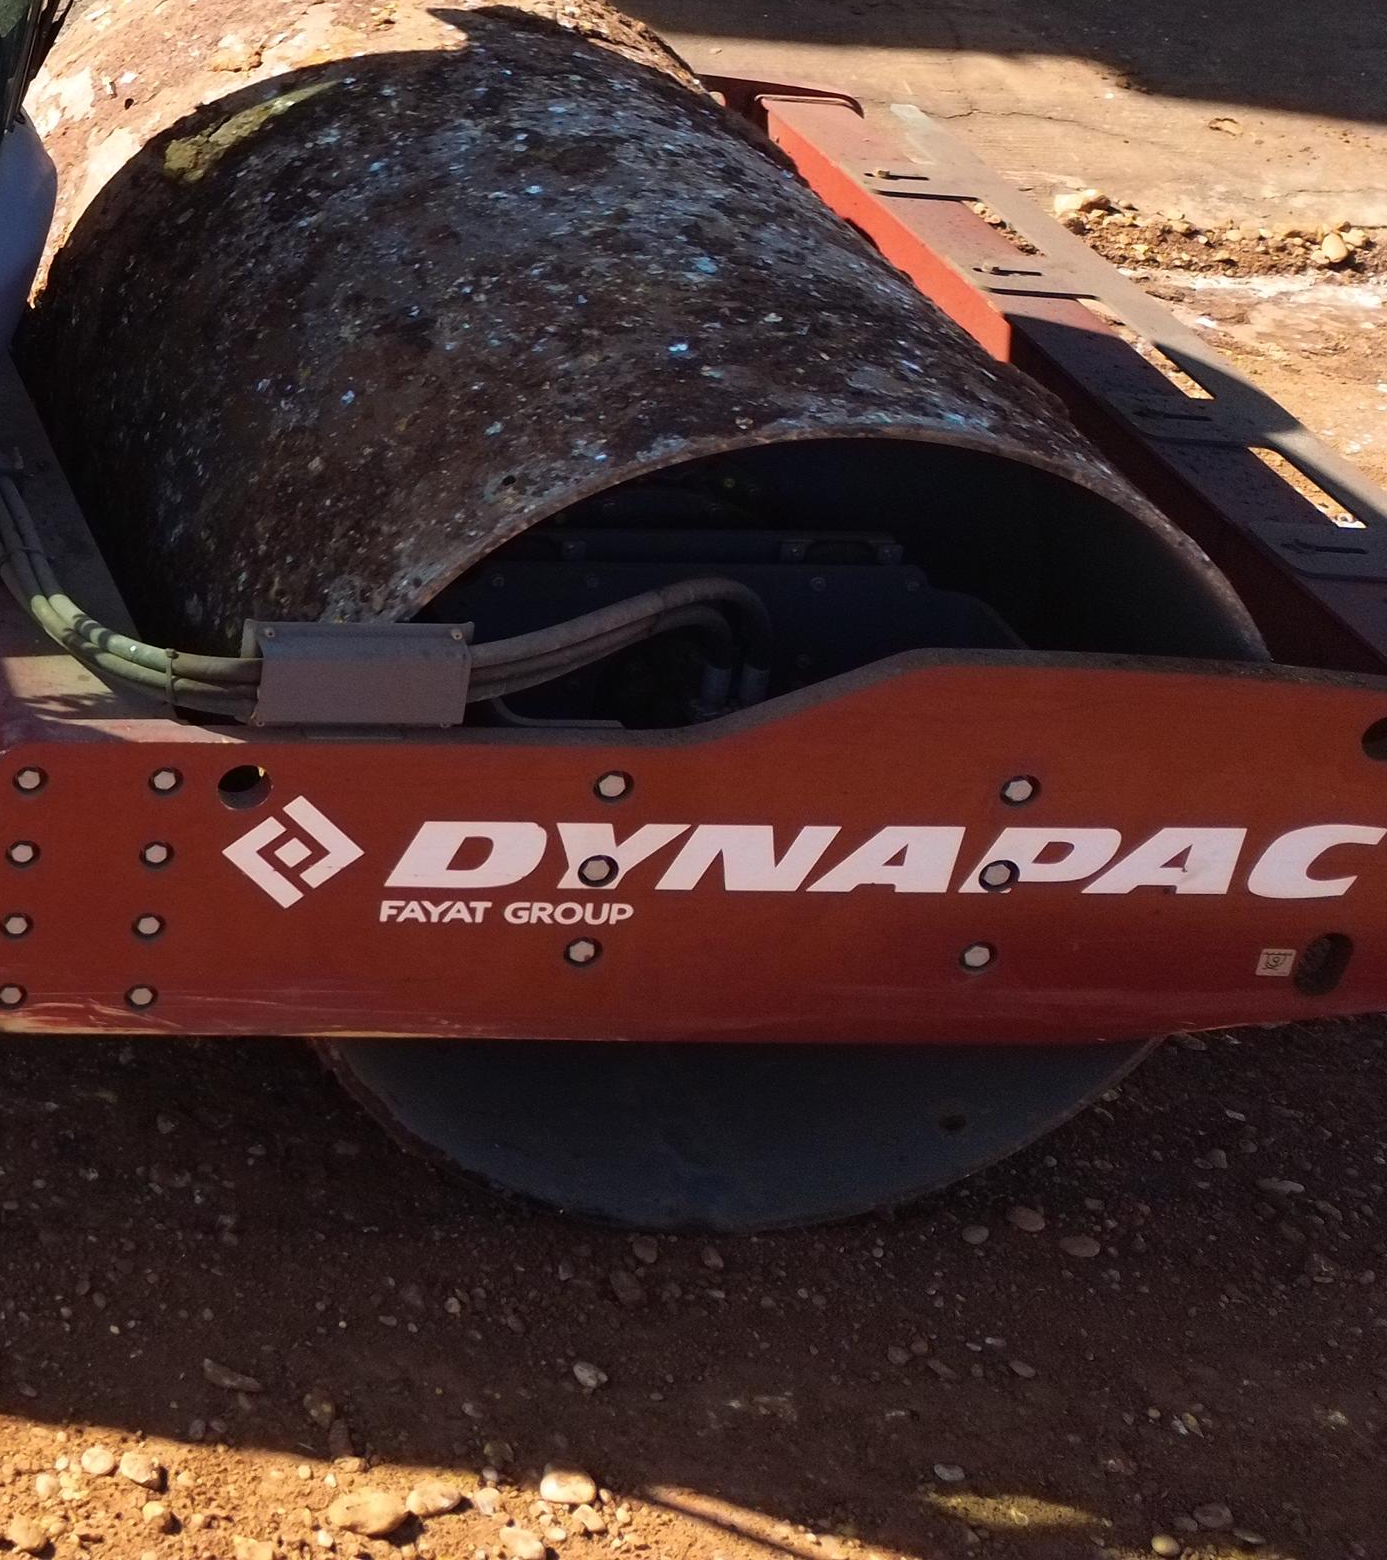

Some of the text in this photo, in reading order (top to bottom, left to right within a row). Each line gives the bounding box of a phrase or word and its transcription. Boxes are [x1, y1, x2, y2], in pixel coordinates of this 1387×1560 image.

[384, 821, 1387, 899] DYNAPAC
[379, 900, 634, 926] FAYAT GROUP
